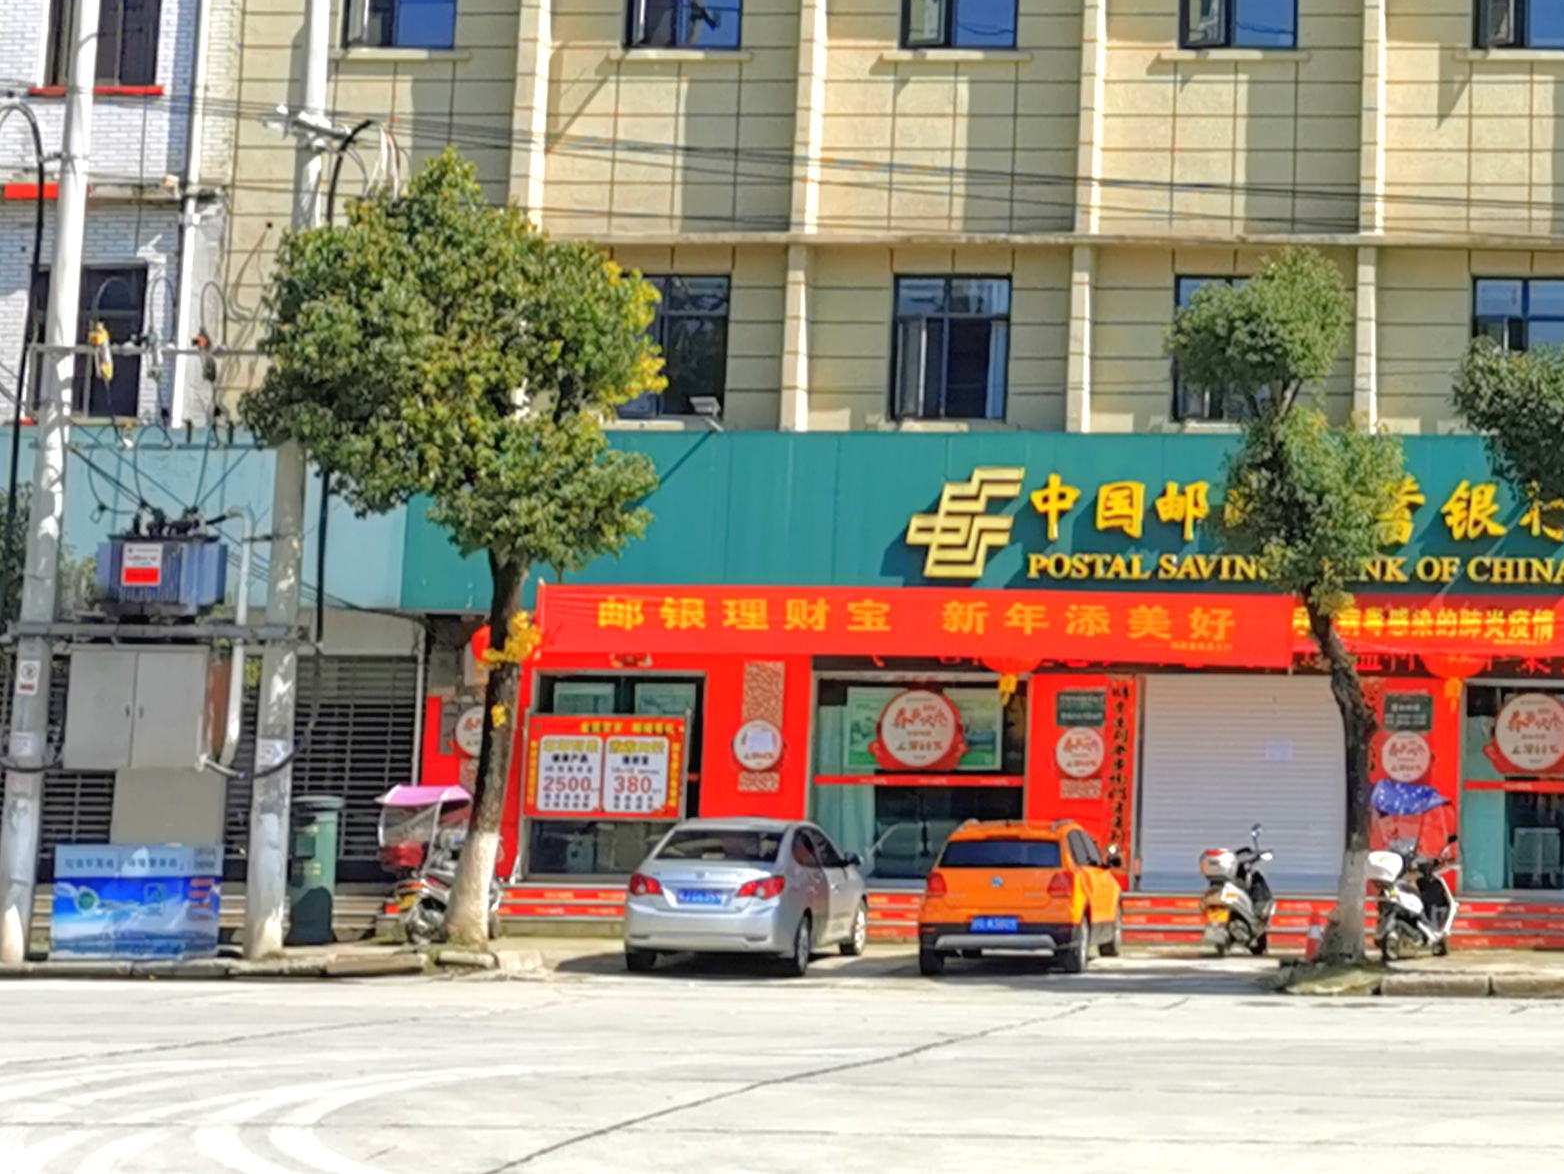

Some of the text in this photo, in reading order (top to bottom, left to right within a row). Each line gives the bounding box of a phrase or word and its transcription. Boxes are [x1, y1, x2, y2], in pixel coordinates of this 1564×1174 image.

[1027, 552, 1152, 579] POSTAL
[1157, 553, 1286, 582] SAVIN
[1415, 555, 1461, 583] OF
[597, 595, 1236, 641] 邮银理财宝 新年添美好
[542, 775, 593, 793] 2500
[613, 775, 653, 794] 380
